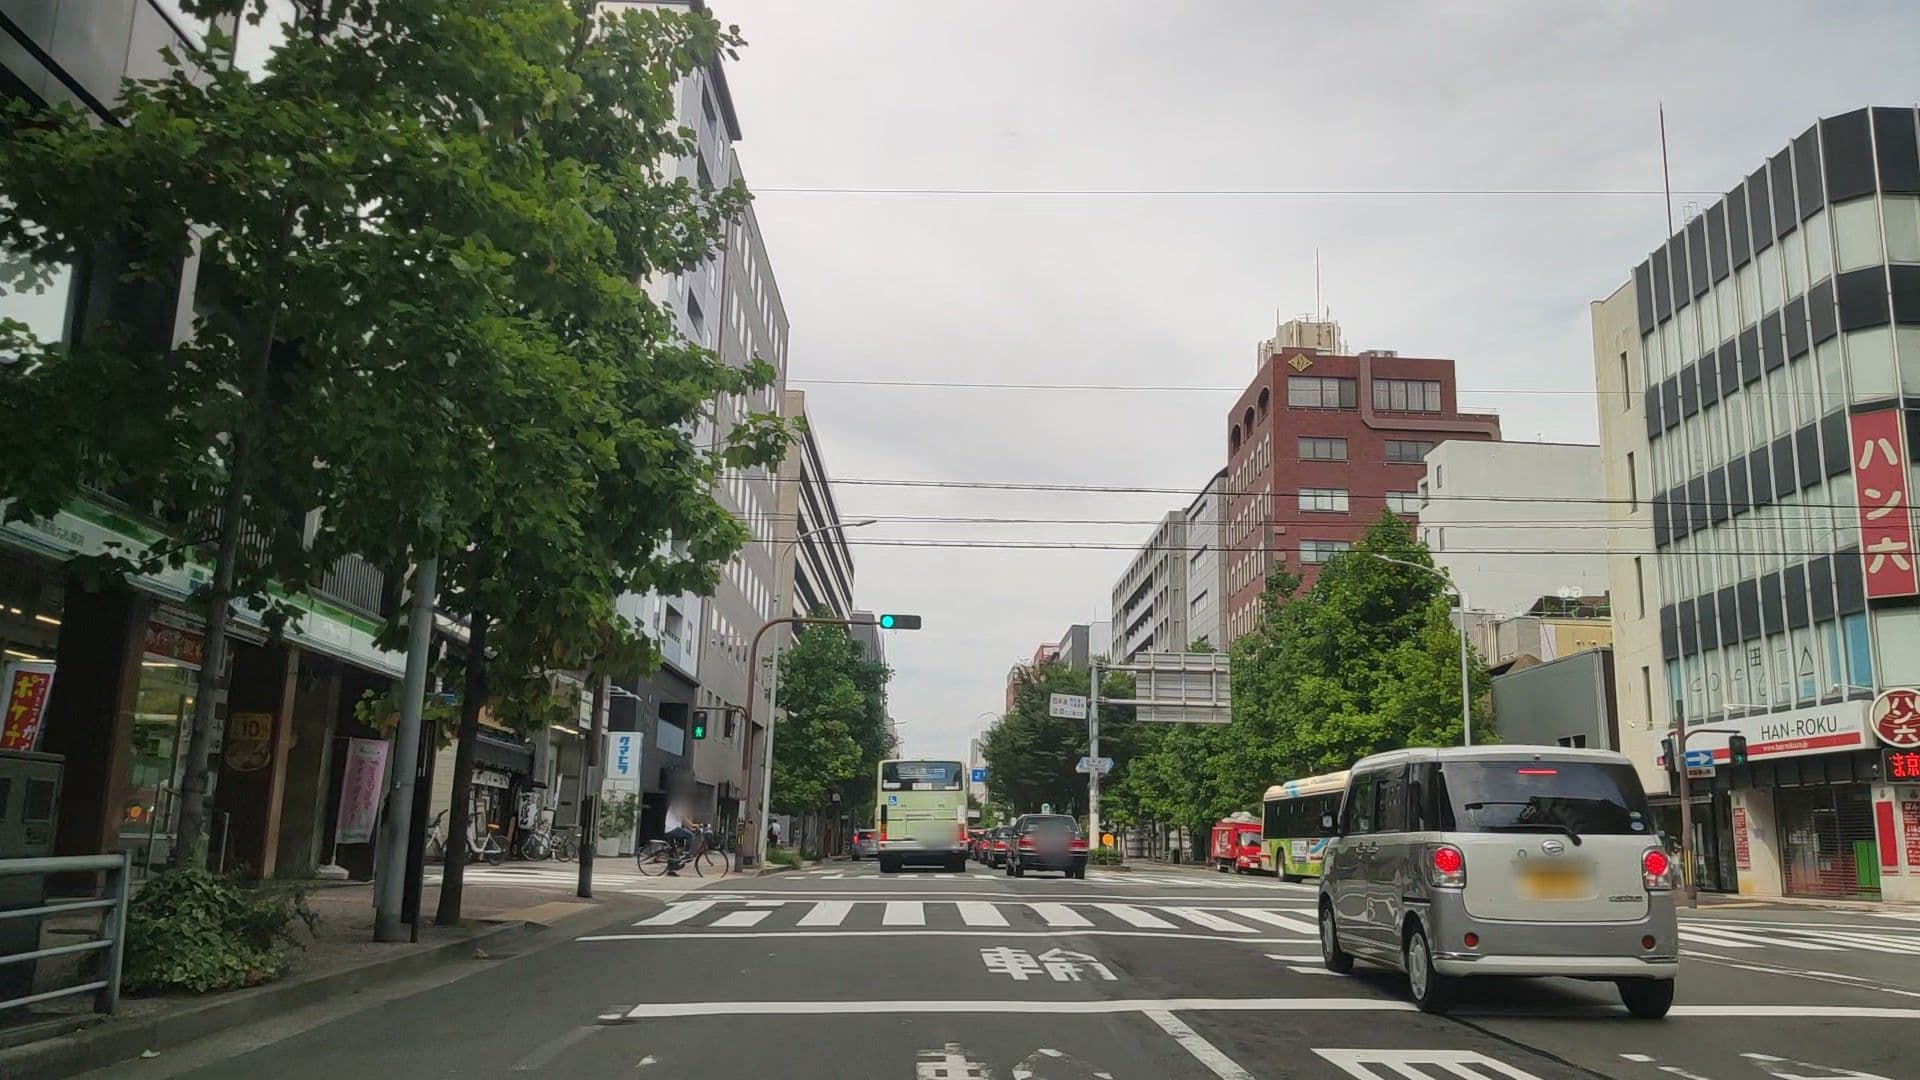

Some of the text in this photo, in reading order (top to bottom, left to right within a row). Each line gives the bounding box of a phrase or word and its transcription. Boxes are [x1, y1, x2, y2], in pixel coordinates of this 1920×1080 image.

[1859, 438, 1911, 575] ハン六
[1761, 715, 1838, 741] HAN-ROKU
[1892, 697, 1919, 743] ハン六
